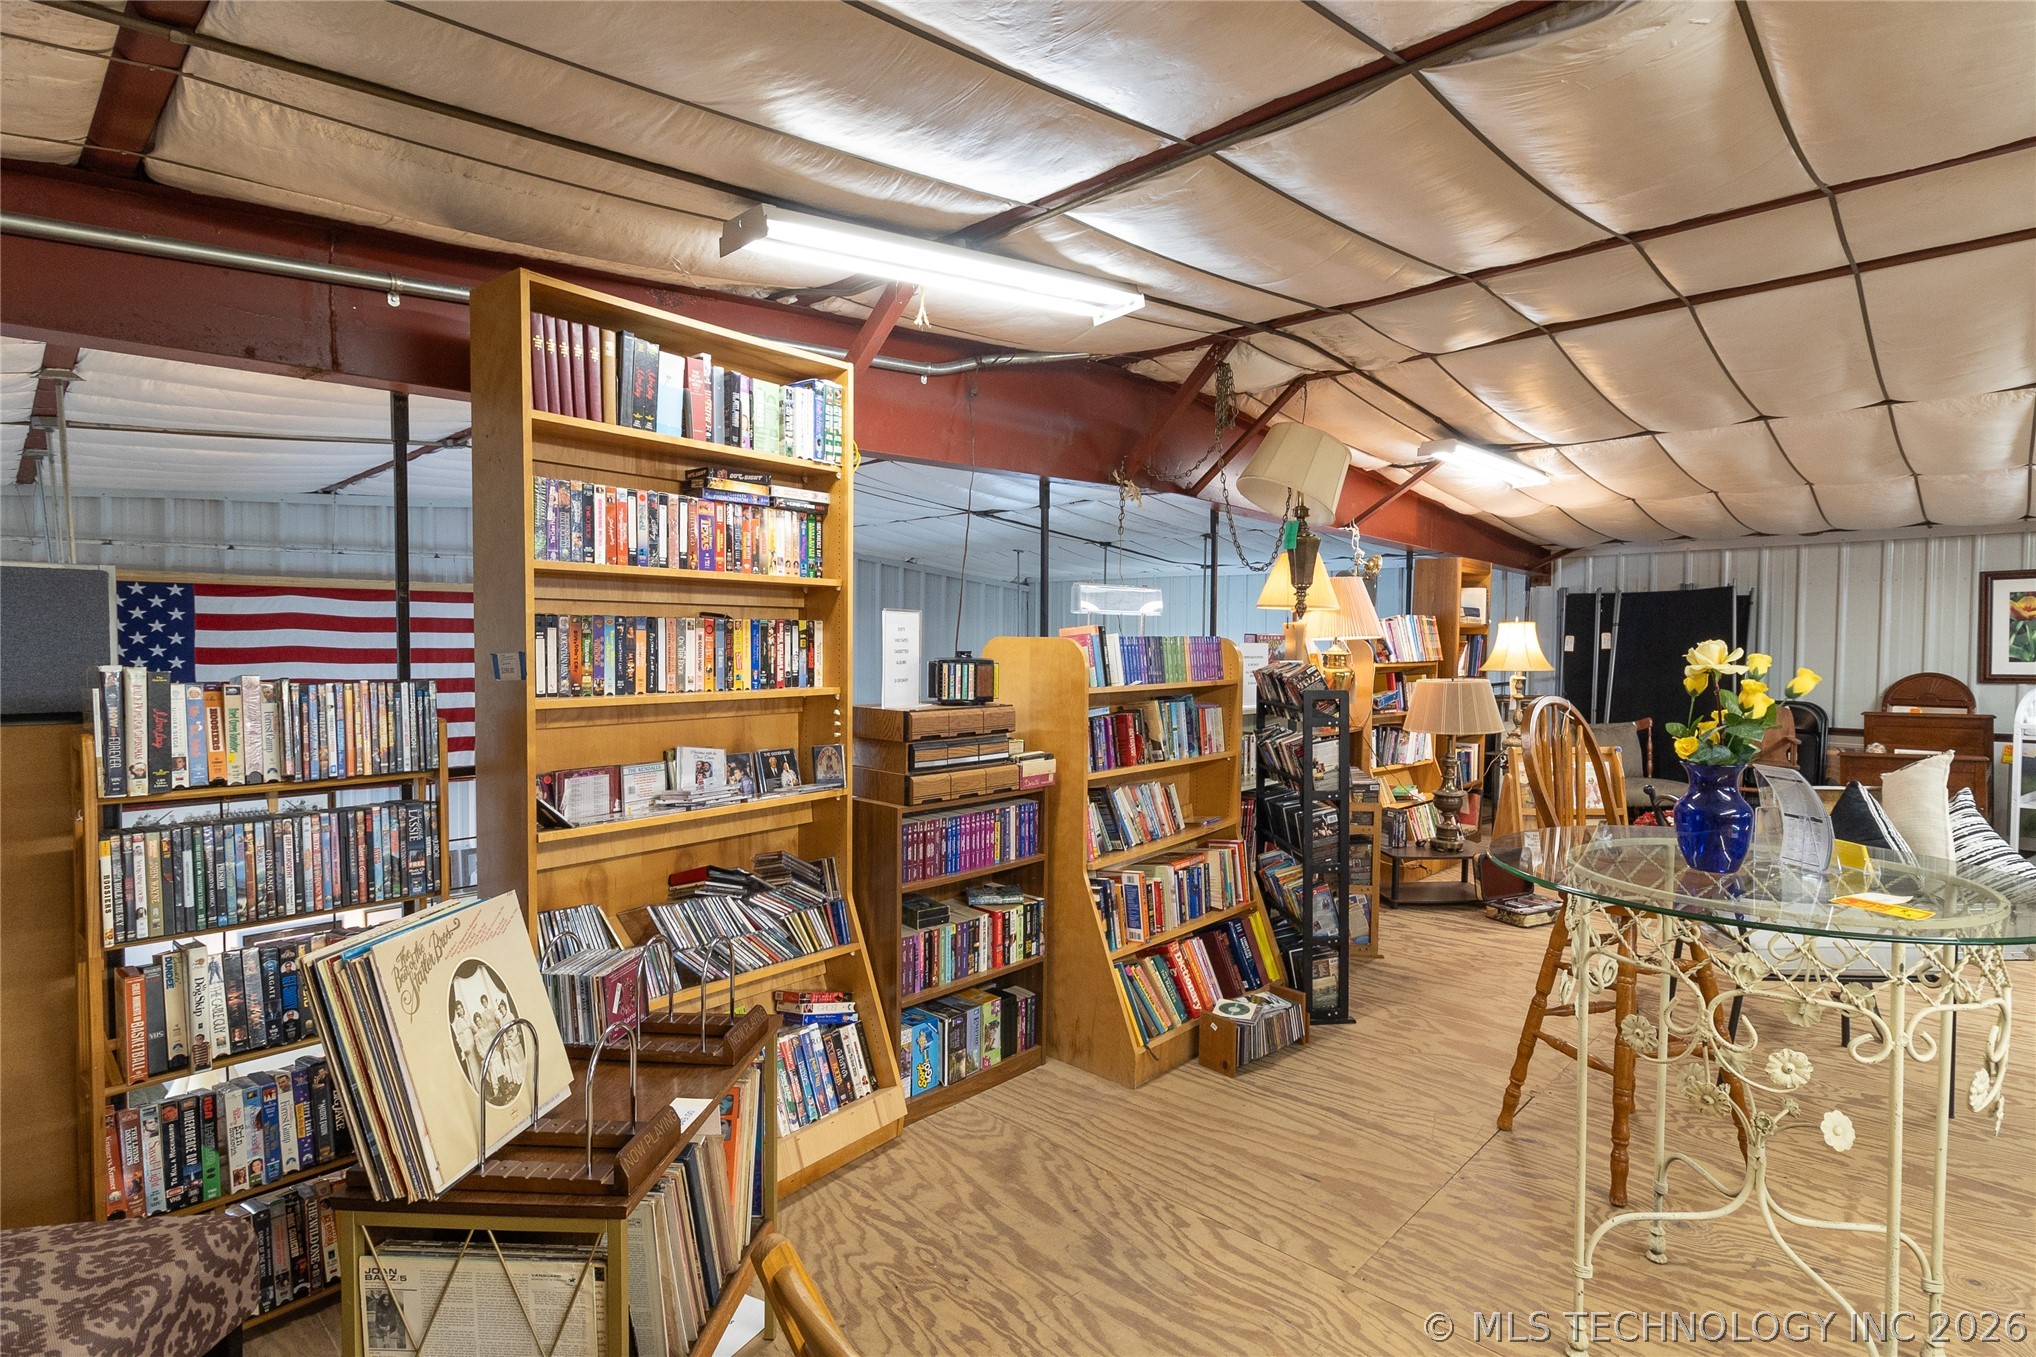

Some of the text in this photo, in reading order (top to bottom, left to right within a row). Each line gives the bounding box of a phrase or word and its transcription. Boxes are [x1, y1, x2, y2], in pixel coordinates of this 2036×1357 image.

[700, 518, 710, 551] TEXAS
[560, 632, 568, 663] MOUNTAIN
[627, 653, 635, 682] MUMMY
[109, 707, 119, 728] NOW
[157, 717, 168, 733] Love
[209, 708, 221, 751] HOOSIERS
[229, 719, 240, 733] Green
[263, 711, 276, 753] Forrest Gump
[409, 703, 417, 748] POSSESSION
[109, 737, 121, 769] FOREVER
[133, 729, 145, 760] CHRISTMAS
[153, 733, 167, 749] Lucy
[640, 764, 662, 772] KENDALLS
[408, 809, 419, 842] LASSIE
[265, 850, 275, 894] OPEN RANGE
[285, 848, 293, 879] FOXWORTHY
[348, 837, 356, 876] SECRETARIAT
[149, 861, 161, 904] JOHN WAYNE
[216, 864, 225, 890] PRESIDIO
[358, 865, 366, 883] Game
[103, 874, 112, 914] HOOSIERS
[116, 915, 124, 927] SKY
[165, 957, 174, 990] DUNDEE
[192, 977, 204, 997] Dog
[268, 962, 276, 999] STARGATE
[1175, 951, 1202, 1010] Dictionary
[193, 997, 205, 1017] Skip
[282, 986, 298, 1009] SHORTY
[1165, 980, 1177, 1003] MASTERS
[210, 986, 225, 1034] THE CABLE GUY
[730, 1008, 766, 1045] NOW PLAYING
[131, 1021, 145, 1072] BASKETBALL
[810, 1057, 822, 1088] Peter Pan
[917, 1064, 927, 1088] Sort
[204, 1096, 213, 1119] RCA
[280, 1100, 292, 1143] Forrest Gump
[303, 1101, 313, 1136] Jerry Lewis
[332, 1105, 345, 1131] JAKE
[124, 1129, 133, 1166] DAYLIGHTS
[167, 1123, 176, 1159] MOCKINGBIRD
[182, 1110, 196, 1166] INDEPENDENCE DAY
[229, 1127, 237, 1157] Brockovich
[234, 1124, 244, 1147] Erin
[624, 1109, 677, 1170] NOW PLAYING
[105, 1136, 117, 1190] Kramer Kramer
[147, 1141, 162, 1188] Saved Light
[288, 1228, 300, 1258] COLLECTOR
[307, 1199, 320, 1264] THE WILD ONE
[365, 1267, 398, 1275] JOAN
